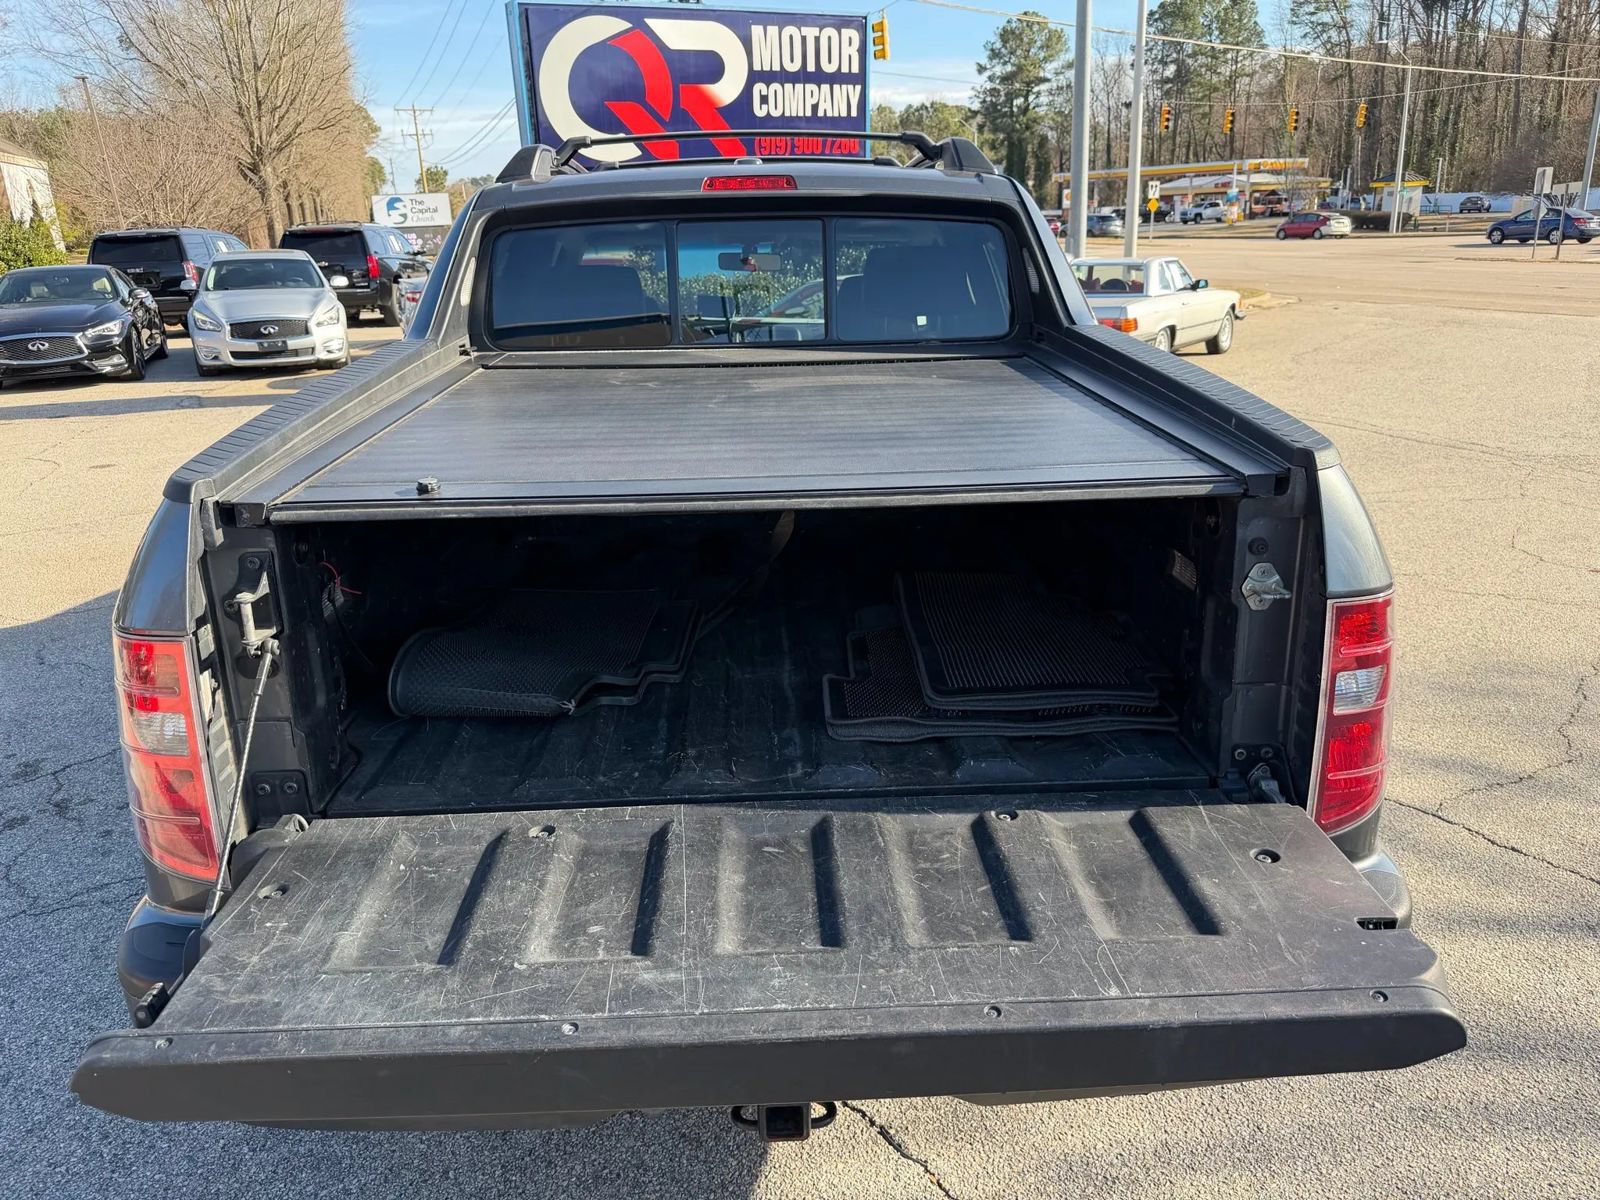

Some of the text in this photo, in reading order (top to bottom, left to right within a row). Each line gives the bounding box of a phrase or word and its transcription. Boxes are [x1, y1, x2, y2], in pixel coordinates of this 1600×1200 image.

[751, 25, 860, 73] MOTOR
[753, 82, 861, 117] COMPANY
[755, 137, 792, 157] (919)
[794, 137, 823, 154] 900
[409, 198, 425, 206] The
[410, 206, 438, 214] Capital
